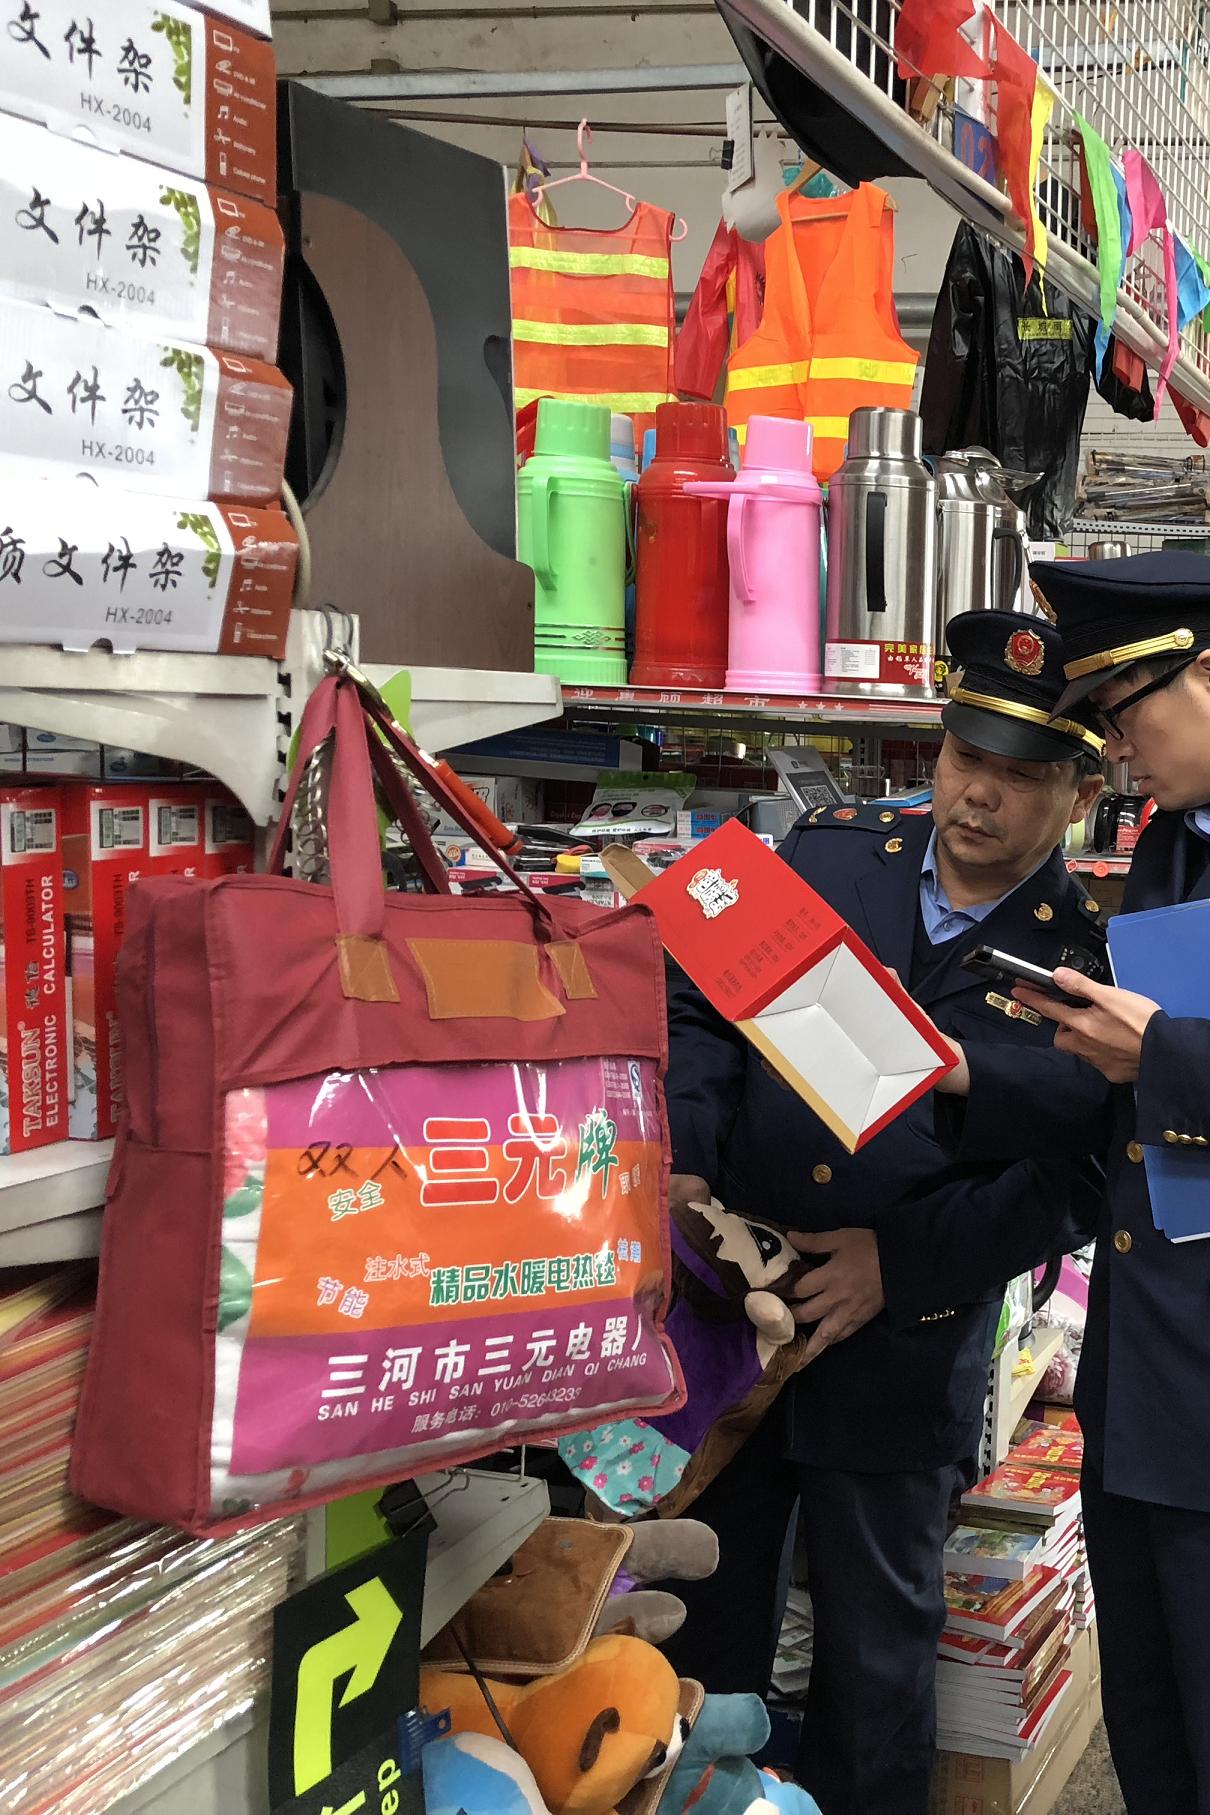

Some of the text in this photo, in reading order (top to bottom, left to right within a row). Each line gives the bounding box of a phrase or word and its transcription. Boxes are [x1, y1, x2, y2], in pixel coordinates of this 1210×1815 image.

[7, 0, 153, 93] 文件架
[80, 92, 151, 132] HX-2004
[15, 186, 161, 268] 文件架
[87, 274, 155, 304] HX-2004
[8, 359, 160, 430] 文件架
[82, 439, 155, 465] HX-2004
[106, 607, 174, 626] HX-2004
[41, 875, 59, 1127] ELECTRONIC CALCULATOR
[21, 1028, 42, 1138] TAKSUN
[297, 1141, 409, 1181] 双人
[328, 1180, 385, 1221] 安全
[364, 1255, 432, 1282] 注水式
[429, 1251, 616, 1306] 精品水暖电热毯
[316, 1276, 369, 1319] 节能
[317, 1353, 648, 1421] SAN HE SHI SAN YUAN DIAN QI CHANG
